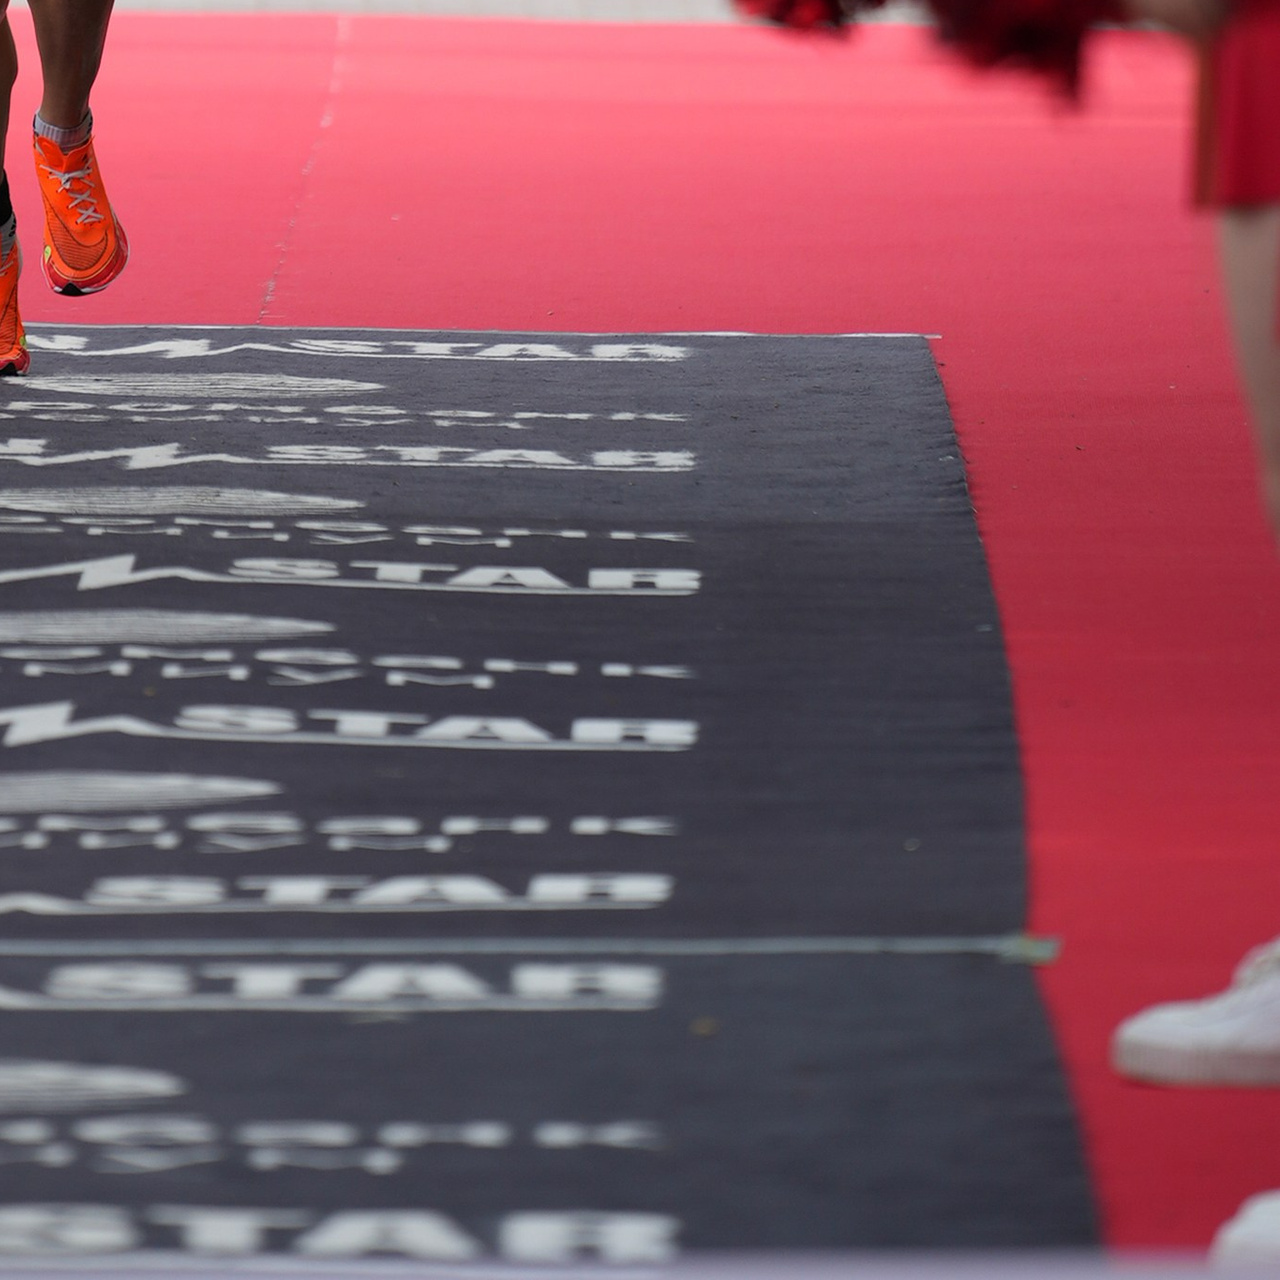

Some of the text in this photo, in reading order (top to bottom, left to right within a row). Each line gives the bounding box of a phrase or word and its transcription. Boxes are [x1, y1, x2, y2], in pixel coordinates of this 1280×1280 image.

[291, 339, 690, 358] STAR
[266, 444, 695, 466] STAR
[229, 557, 702, 589] STAR
[174, 703, 696, 744] STAR
[89, 872, 670, 905] STAR
[46, 961, 661, 1000] STAR
